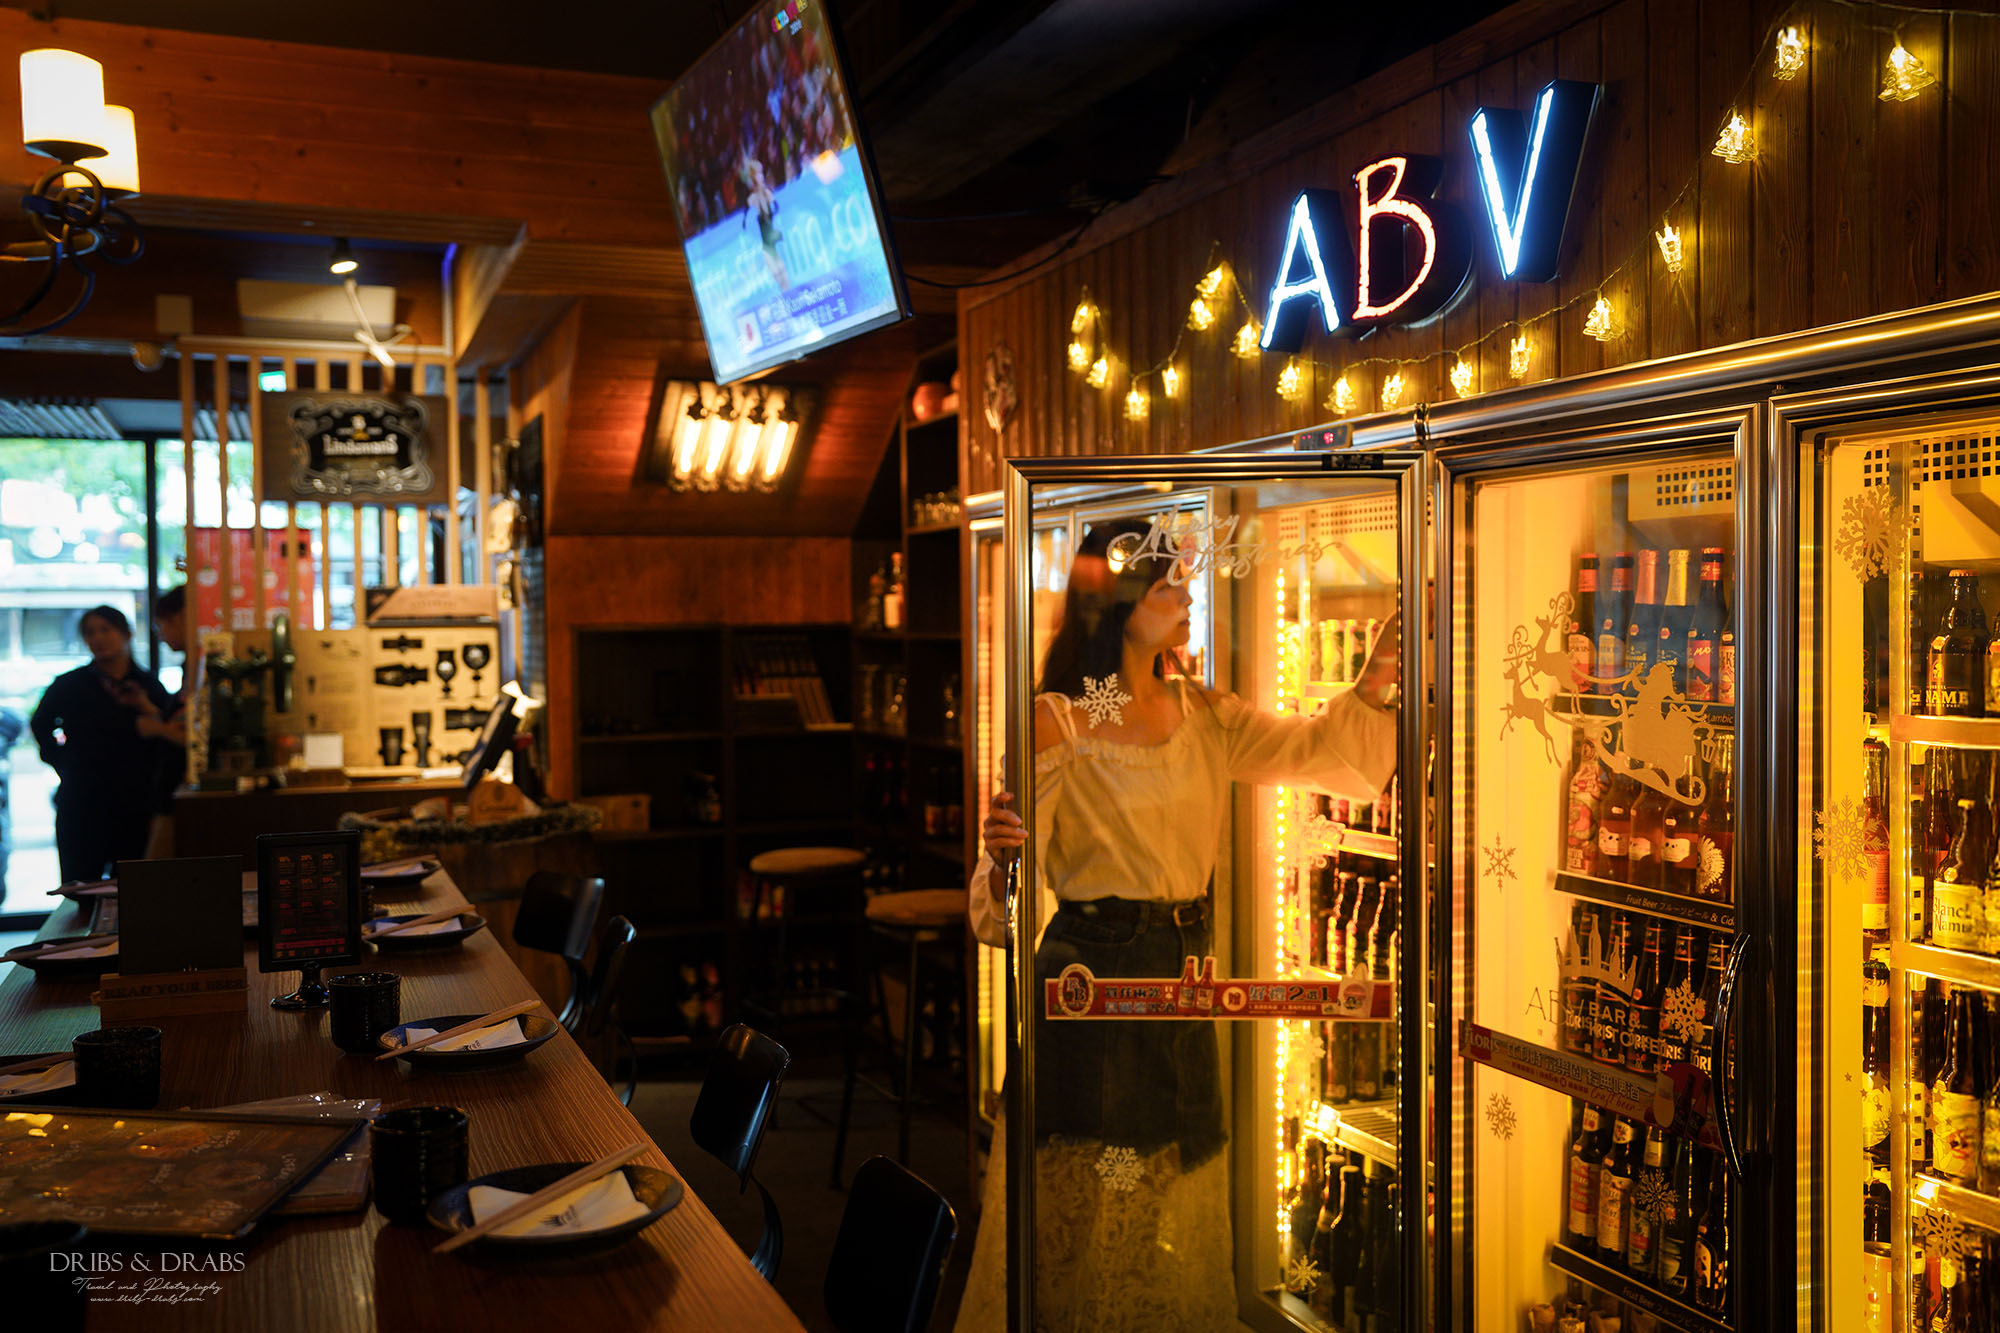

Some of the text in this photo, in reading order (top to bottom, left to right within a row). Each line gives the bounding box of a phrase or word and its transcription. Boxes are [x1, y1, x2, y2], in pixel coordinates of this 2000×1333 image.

[1259, 82, 1556, 352] ABV
[323, 433, 399, 456] Lindemans
[1107, 504, 1239, 570] Merry
[1167, 541, 1342, 586] Christmas
[1626, 894, 1641, 905] Fruit
[1642, 897, 1658, 909] Beer
[1711, 912, 1718, 923] &
[1588, 1000, 1627, 1026] BAR
[1628, 1010, 1642, 1030] &
[1464, 1025, 1500, 1053] FLORIS
[1657, 1037, 1685, 1062] ORIS
[1590, 1088, 1615, 1106] Craft
